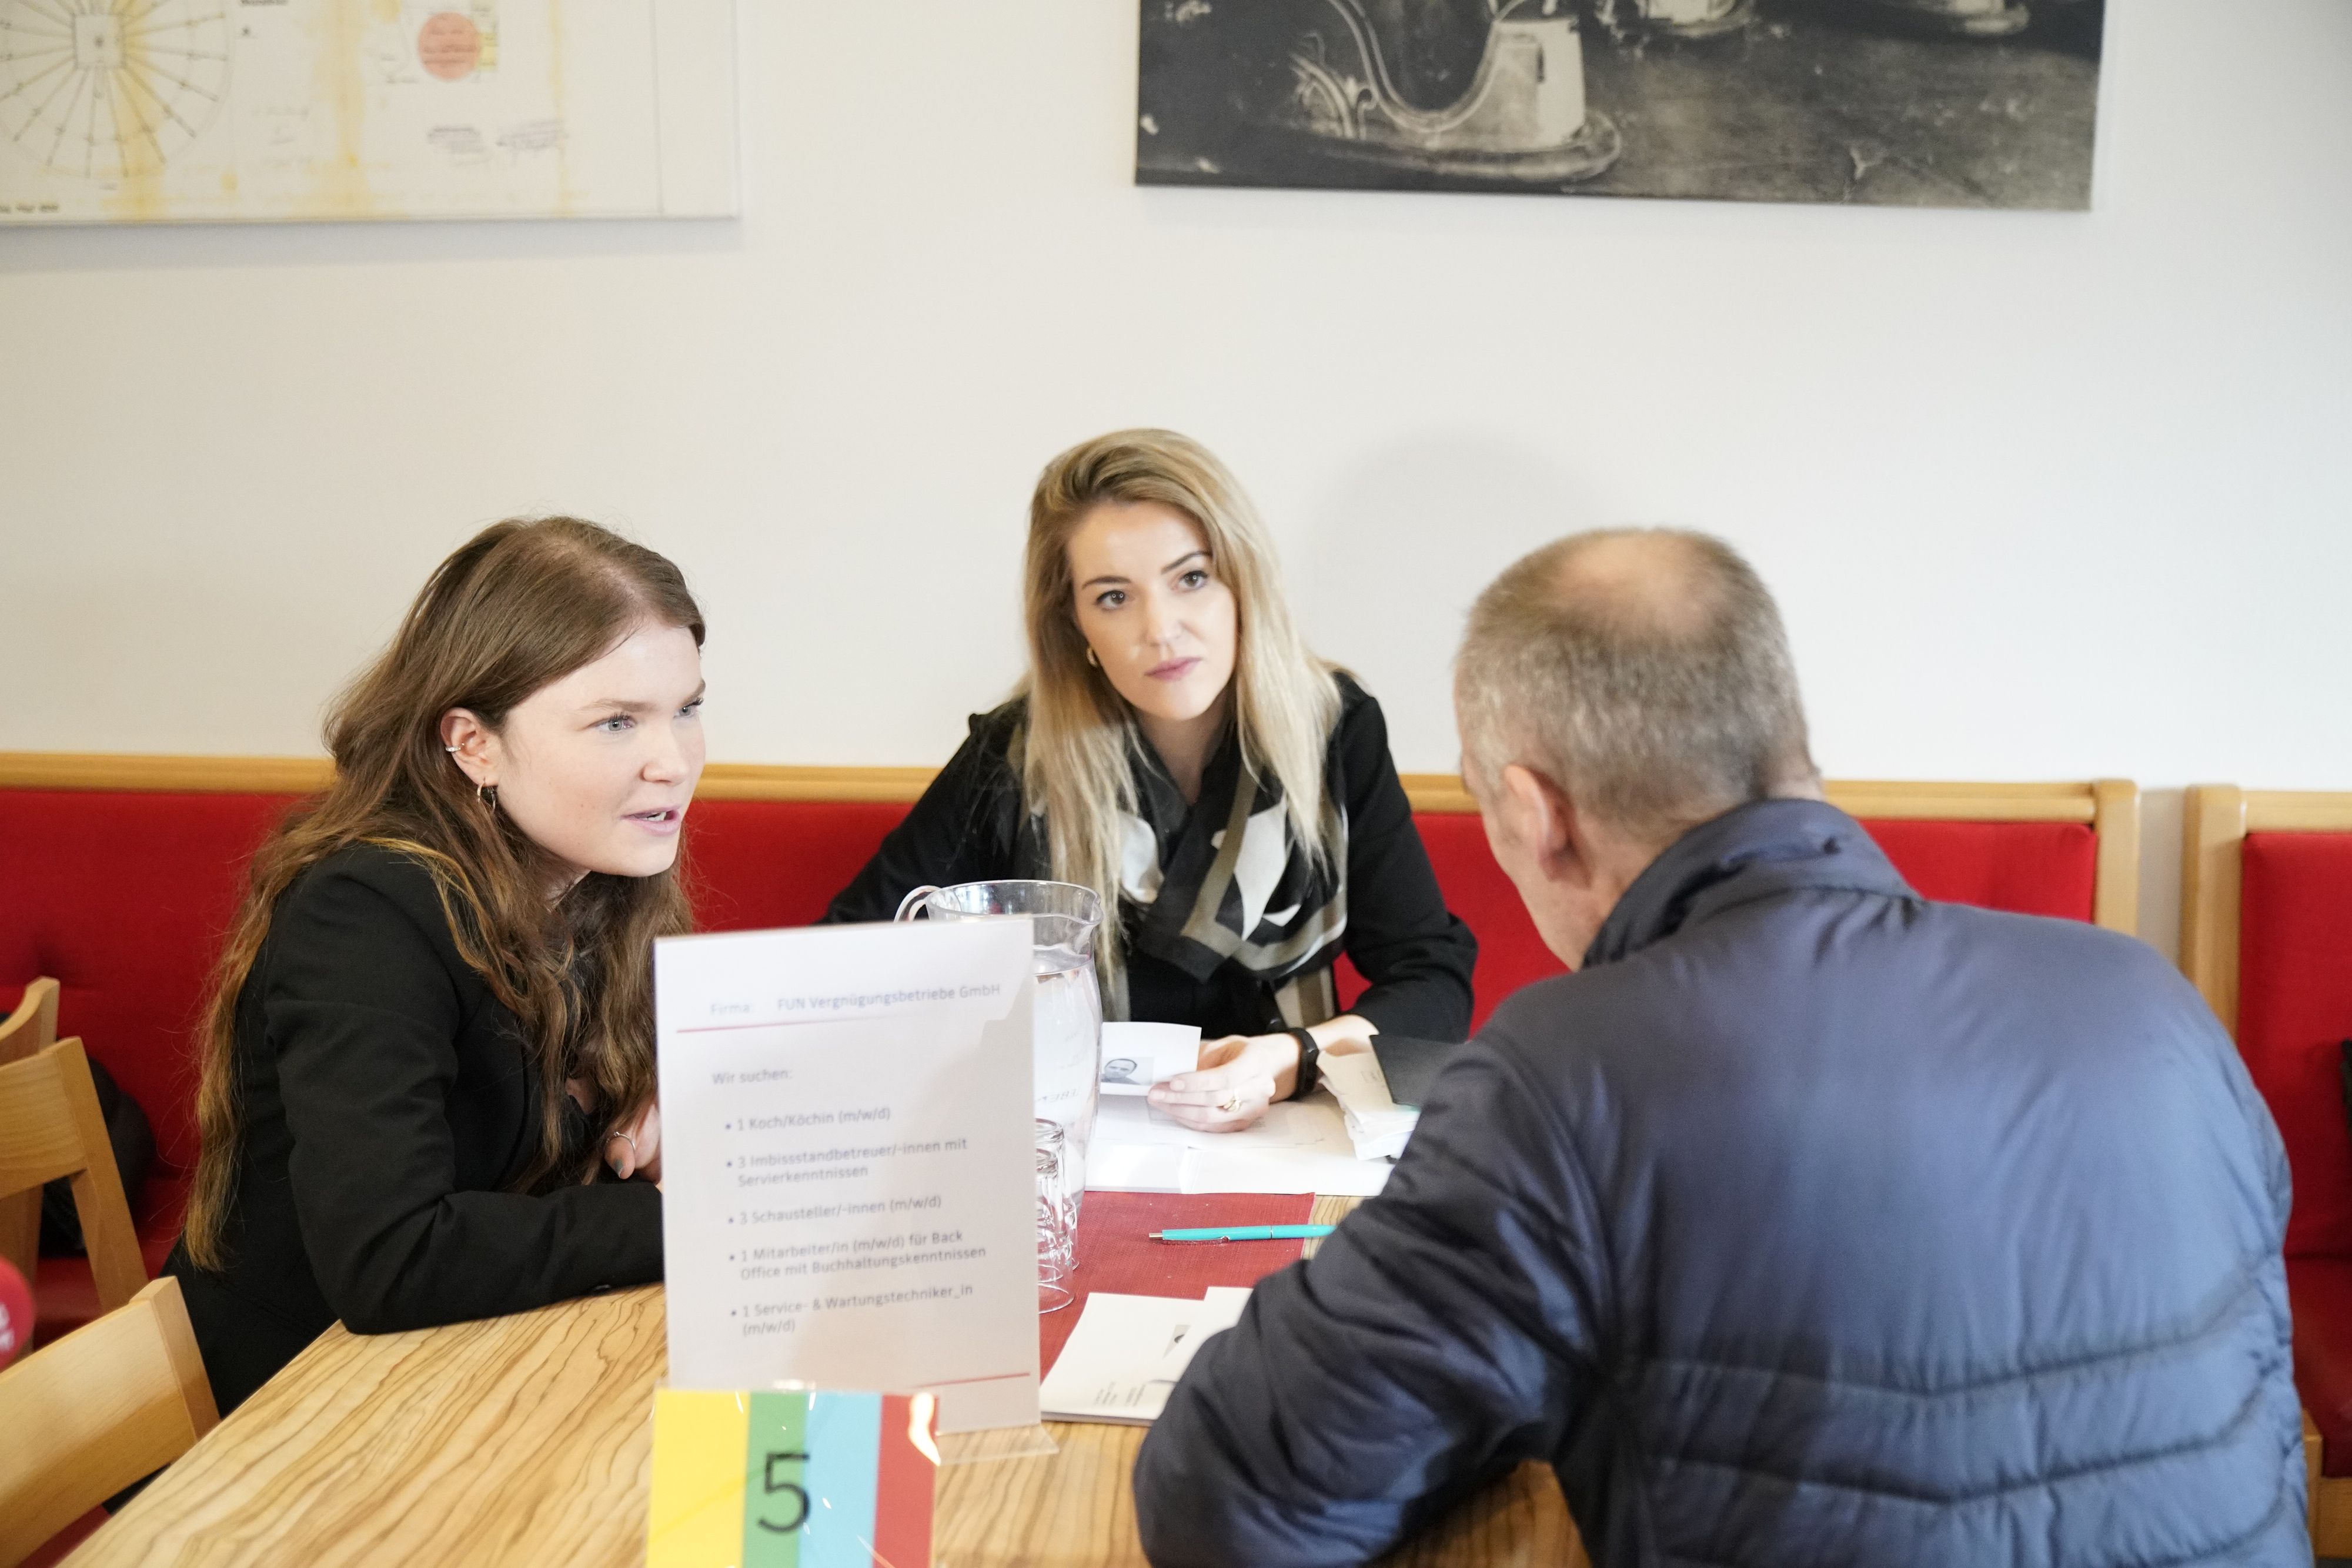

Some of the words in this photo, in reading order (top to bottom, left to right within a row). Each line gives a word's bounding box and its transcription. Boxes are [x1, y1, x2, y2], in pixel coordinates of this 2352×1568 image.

[778, 998, 806, 1011] FUN
[811, 988, 955, 1009] Vergnügungsbetriebe
[960, 984, 1001, 998] GmbH
[712, 1072, 734, 1085] Wir
[739, 1068, 793, 1083] suchen:
[738, 1119, 744, 1132] 1
[749, 1112, 834, 1131] Koch/Köchin
[838, 1108, 891, 1124] (m/w/d)
[945, 1138, 967, 1151] mit
[739, 1165, 868, 1187] Servierkenntnissen
[752, 1202, 885, 1223] Schausteller/-innen
[890, 1196, 941, 1212] (m/w/d)
[741, 1249, 747, 1262] 1
[753, 1241, 848, 1261] Mitarbeiter/in
[853, 1237, 905, 1252] (m/w/d)
[909, 1233, 927, 1246] für
[933, 1231, 963, 1243] Back
[741, 1266, 780, 1280] Office
[786, 1262, 807, 1276] mit
[812, 1248, 986, 1274] Buchhaltungskenntnissen
[743, 1305, 749, 1317] 1
[754, 1301, 807, 1316] Service-
[813, 1299, 821, 1310] &
[826, 1284, 973, 1309] Wartungstechniker_in
[743, 1319, 795, 1336] (m/w/d)
[757, 1452, 810, 1533] 5
